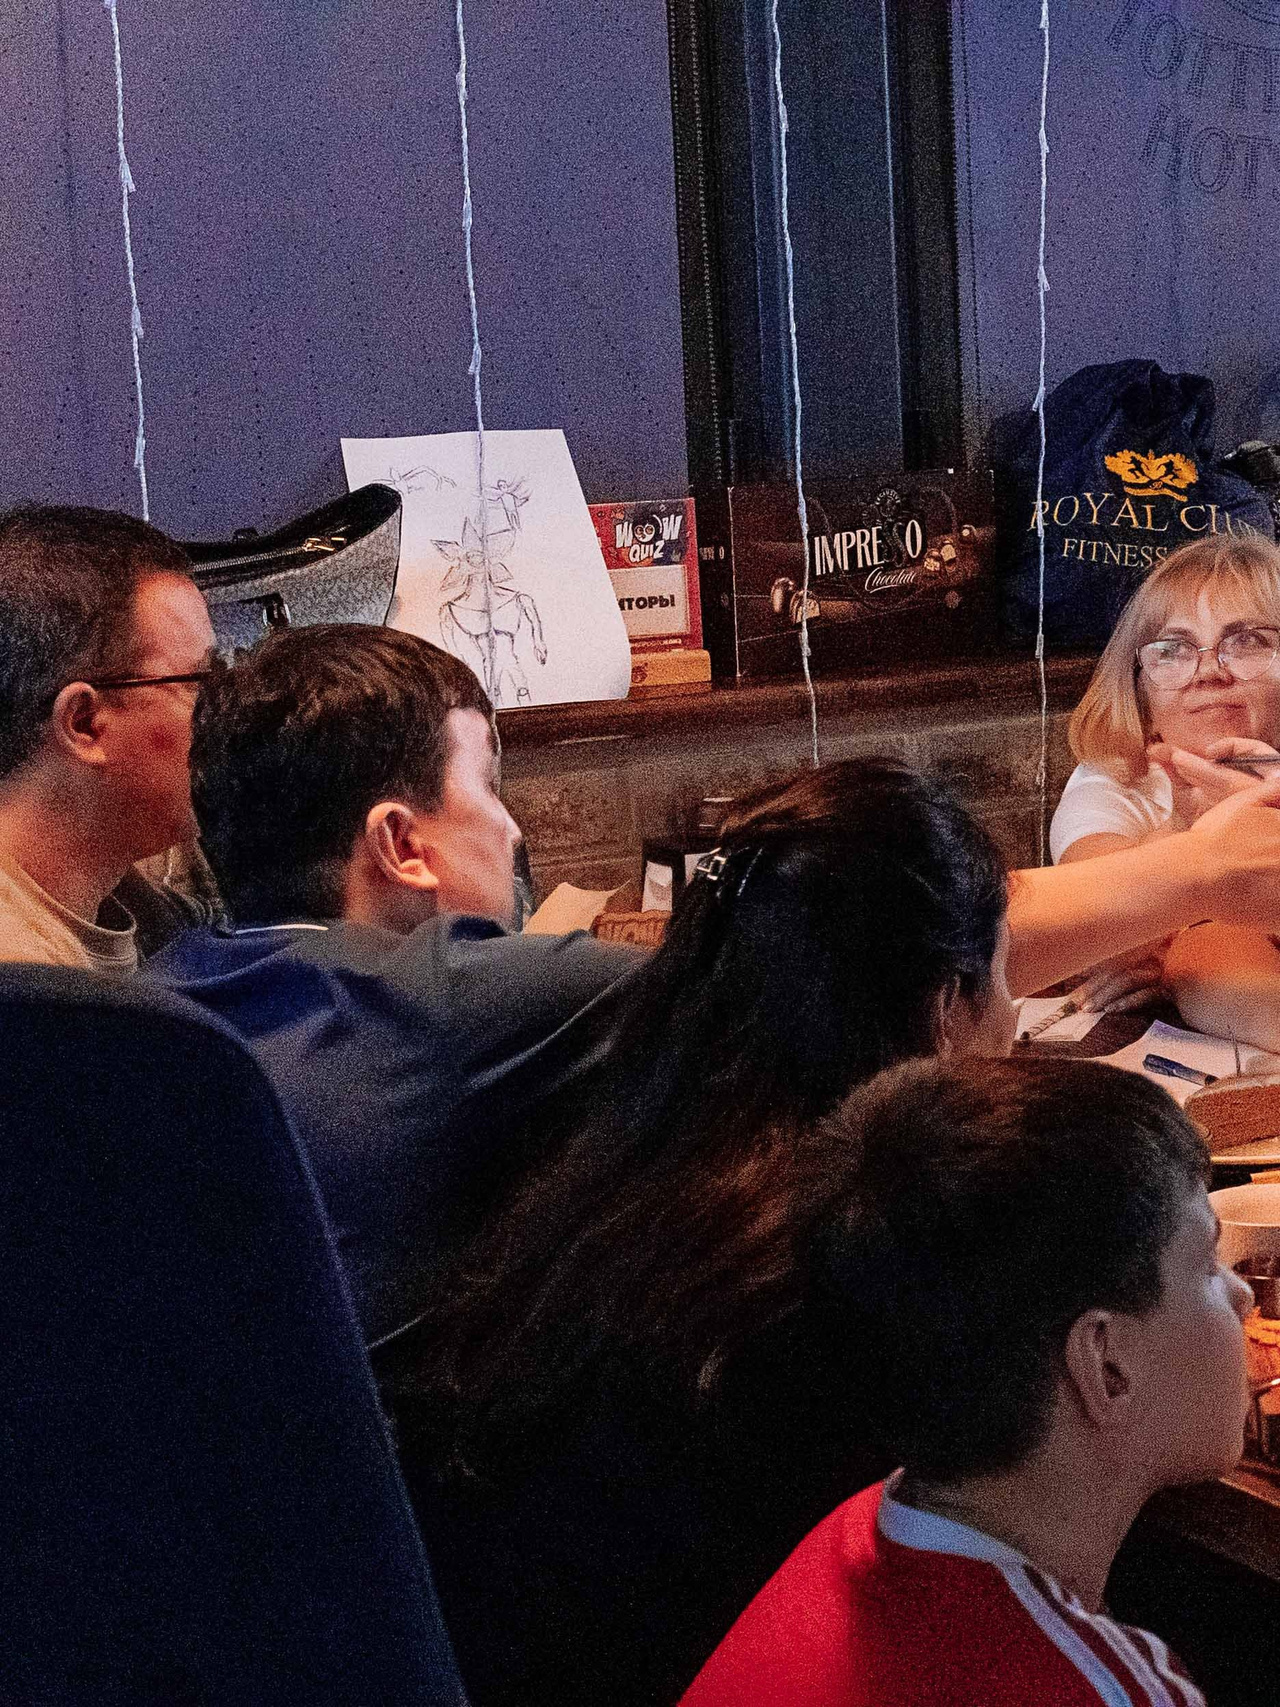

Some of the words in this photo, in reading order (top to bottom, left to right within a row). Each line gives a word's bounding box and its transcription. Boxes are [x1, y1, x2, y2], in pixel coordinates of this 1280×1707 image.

[1027, 492, 1169, 532] ROYAL
[629, 540, 665, 563] QUIZ
[1062, 538, 1168, 568] FITNESS
